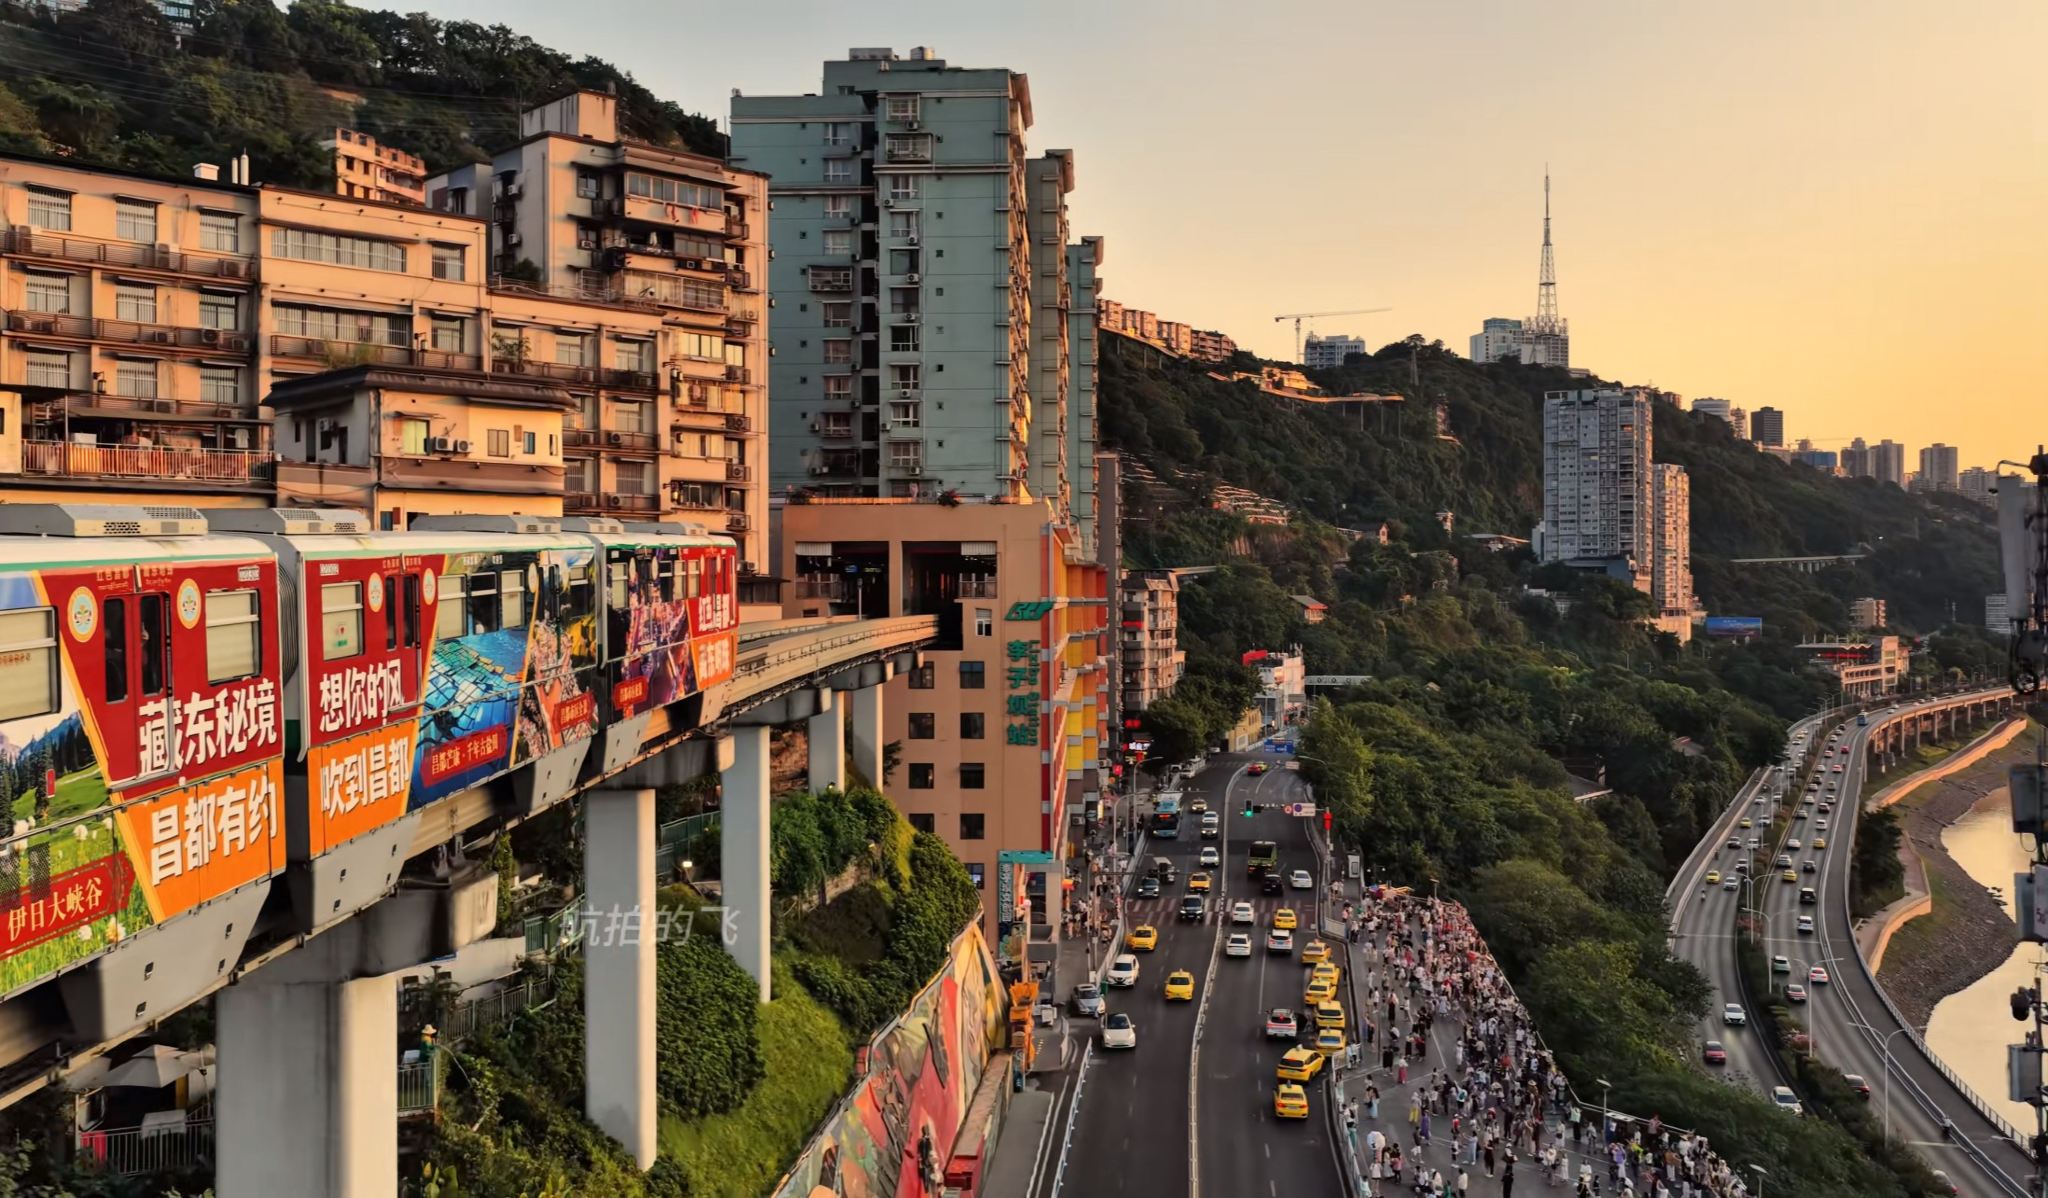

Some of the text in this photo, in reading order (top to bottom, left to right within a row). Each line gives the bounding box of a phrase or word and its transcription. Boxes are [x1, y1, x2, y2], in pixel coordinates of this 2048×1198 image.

[139, 677, 278, 777] 藏东秘境
[319, 657, 405, 733] 想你的风
[1007, 639, 1029, 746] 李子坝站
[319, 735, 410, 820] 吹到昌都
[151, 774, 278, 887] 昌都有约
[7, 876, 104, 943] 伊日大峡谷
